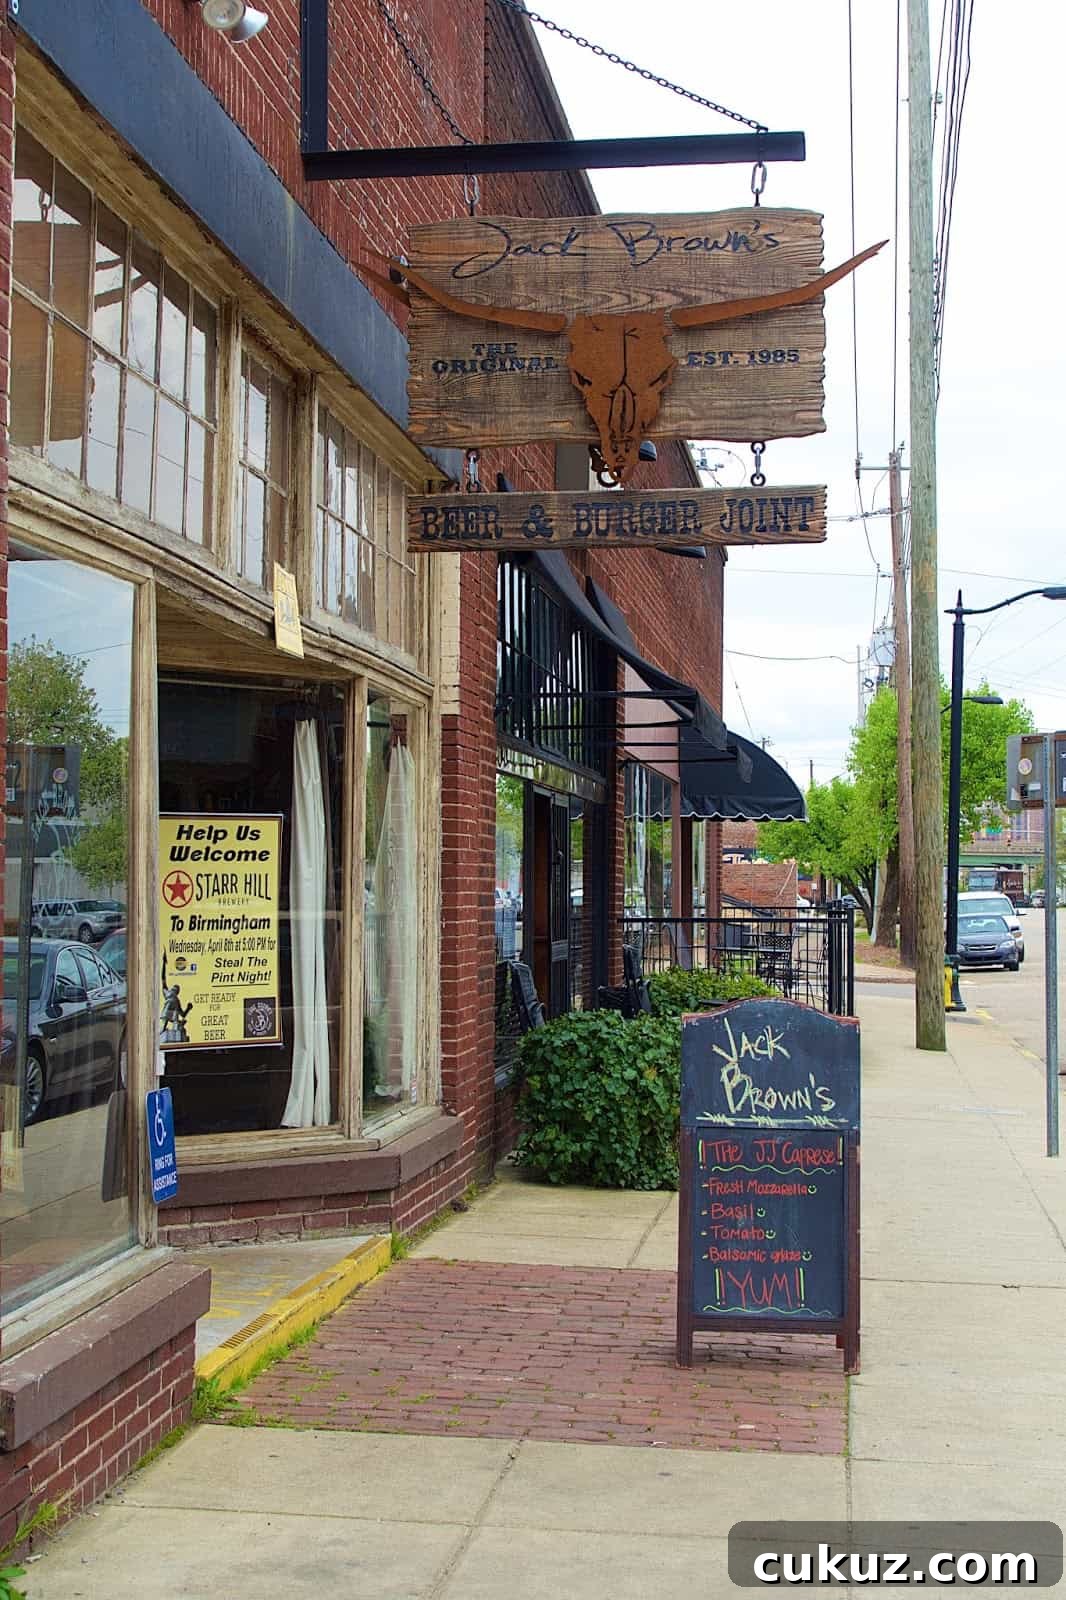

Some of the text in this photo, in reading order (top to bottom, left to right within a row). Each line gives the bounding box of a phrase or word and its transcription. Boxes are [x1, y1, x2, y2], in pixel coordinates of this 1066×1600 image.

[452, 221, 587, 279] Jack
[471, 342, 519, 359] THE
[686, 348, 800, 368] EST. 1985
[432, 354, 559, 376] ORIGINAL
[420, 496, 815, 541] BEER & BURGER JOINT
[176, 824, 261, 844] Help Us
[169, 846, 270, 862] Welcome
[195, 872, 271, 901] STARR HILL
[170, 915, 271, 934] To Birmingham
[208, 939, 222, 956] April
[223, 939, 234, 952] 8th
[234, 940, 241, 951] at
[242, 938, 256, 951] 5:00
[257, 938, 266, 951] PM
[267, 937, 276, 950] for
[214, 956, 268, 968] Steal The
[211, 972, 234, 983] Pint
[237, 970, 272, 984] Night!
[194, 992, 236, 1004] GET READY
[200, 1015, 229, 1026] GREAT
[204, 1030, 226, 1041] BEER
[165, 1152, 174, 1166] FOR
[753, 1140, 776, 1163] JJ
[153, 1171, 177, 1192] ASSISTANCE
